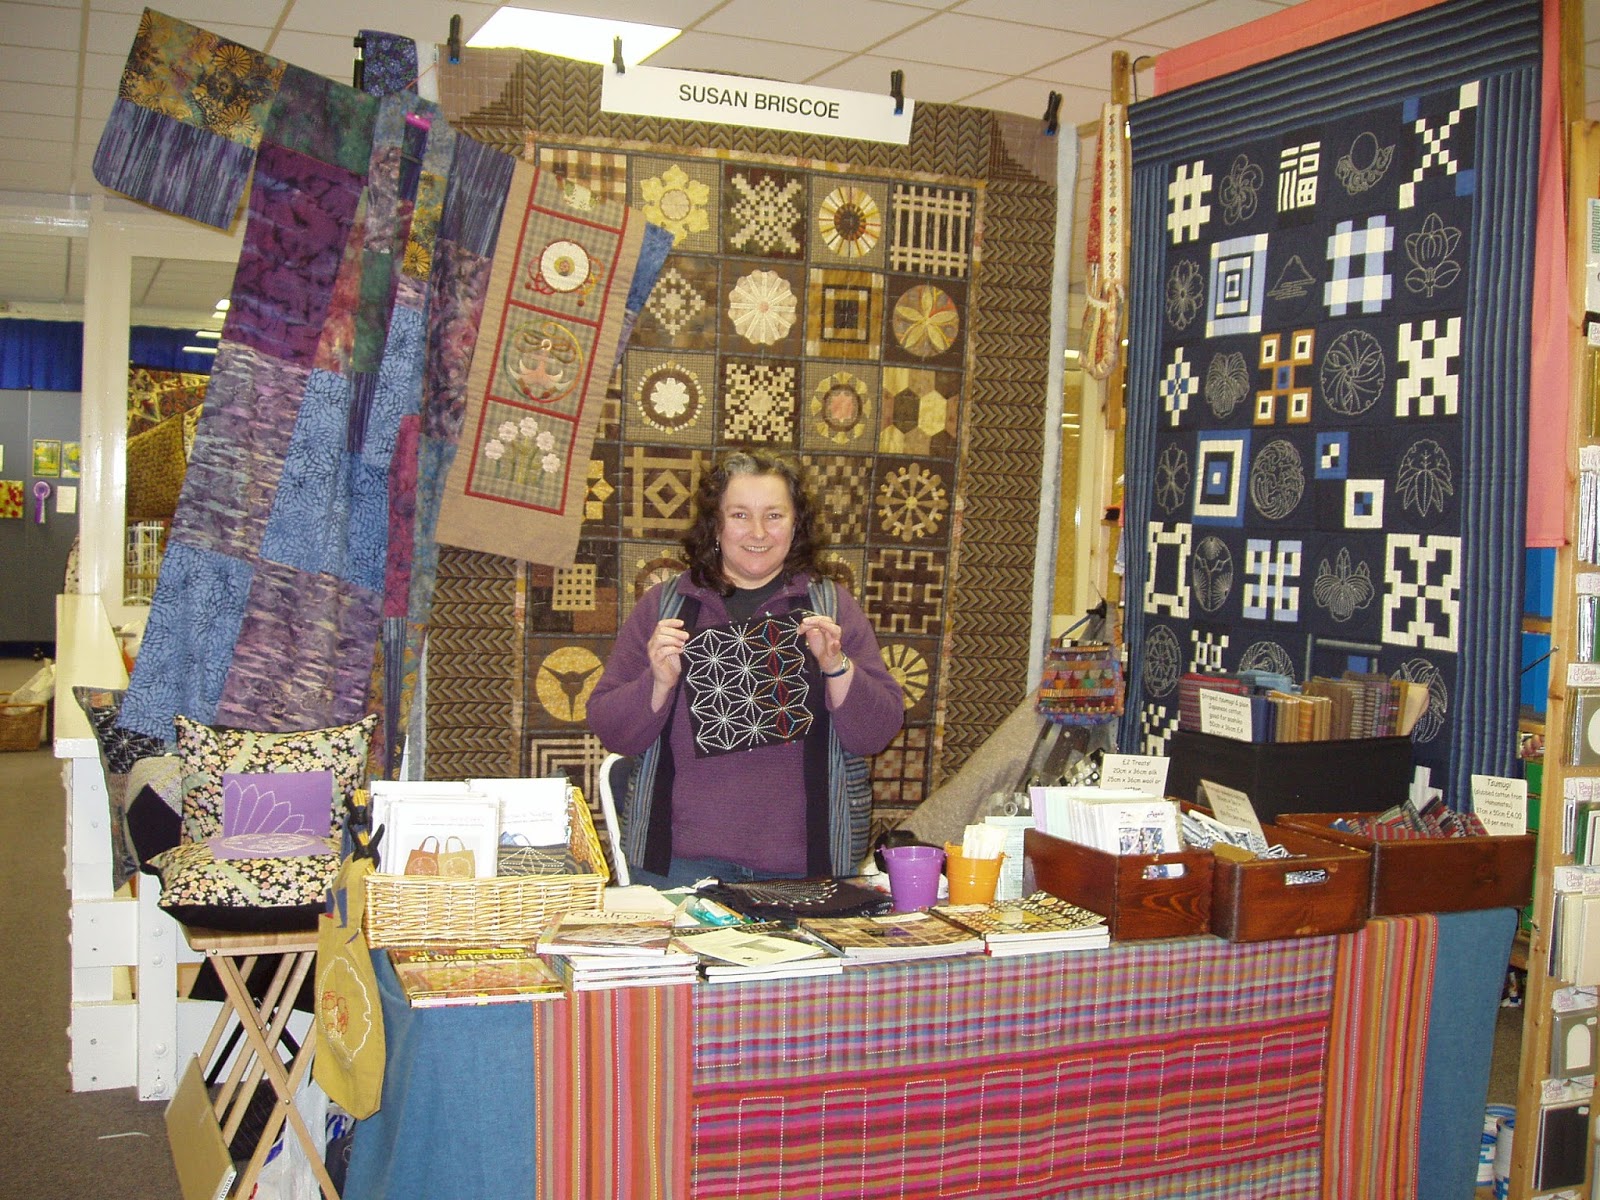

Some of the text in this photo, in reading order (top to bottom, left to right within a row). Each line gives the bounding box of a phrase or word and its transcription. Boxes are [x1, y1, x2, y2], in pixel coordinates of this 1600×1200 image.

[679, 84, 840, 120] SUSAN BRISCOE
[1487, 778, 1513, 790] Tsumugi
[433, 953, 488, 961] Quarter
